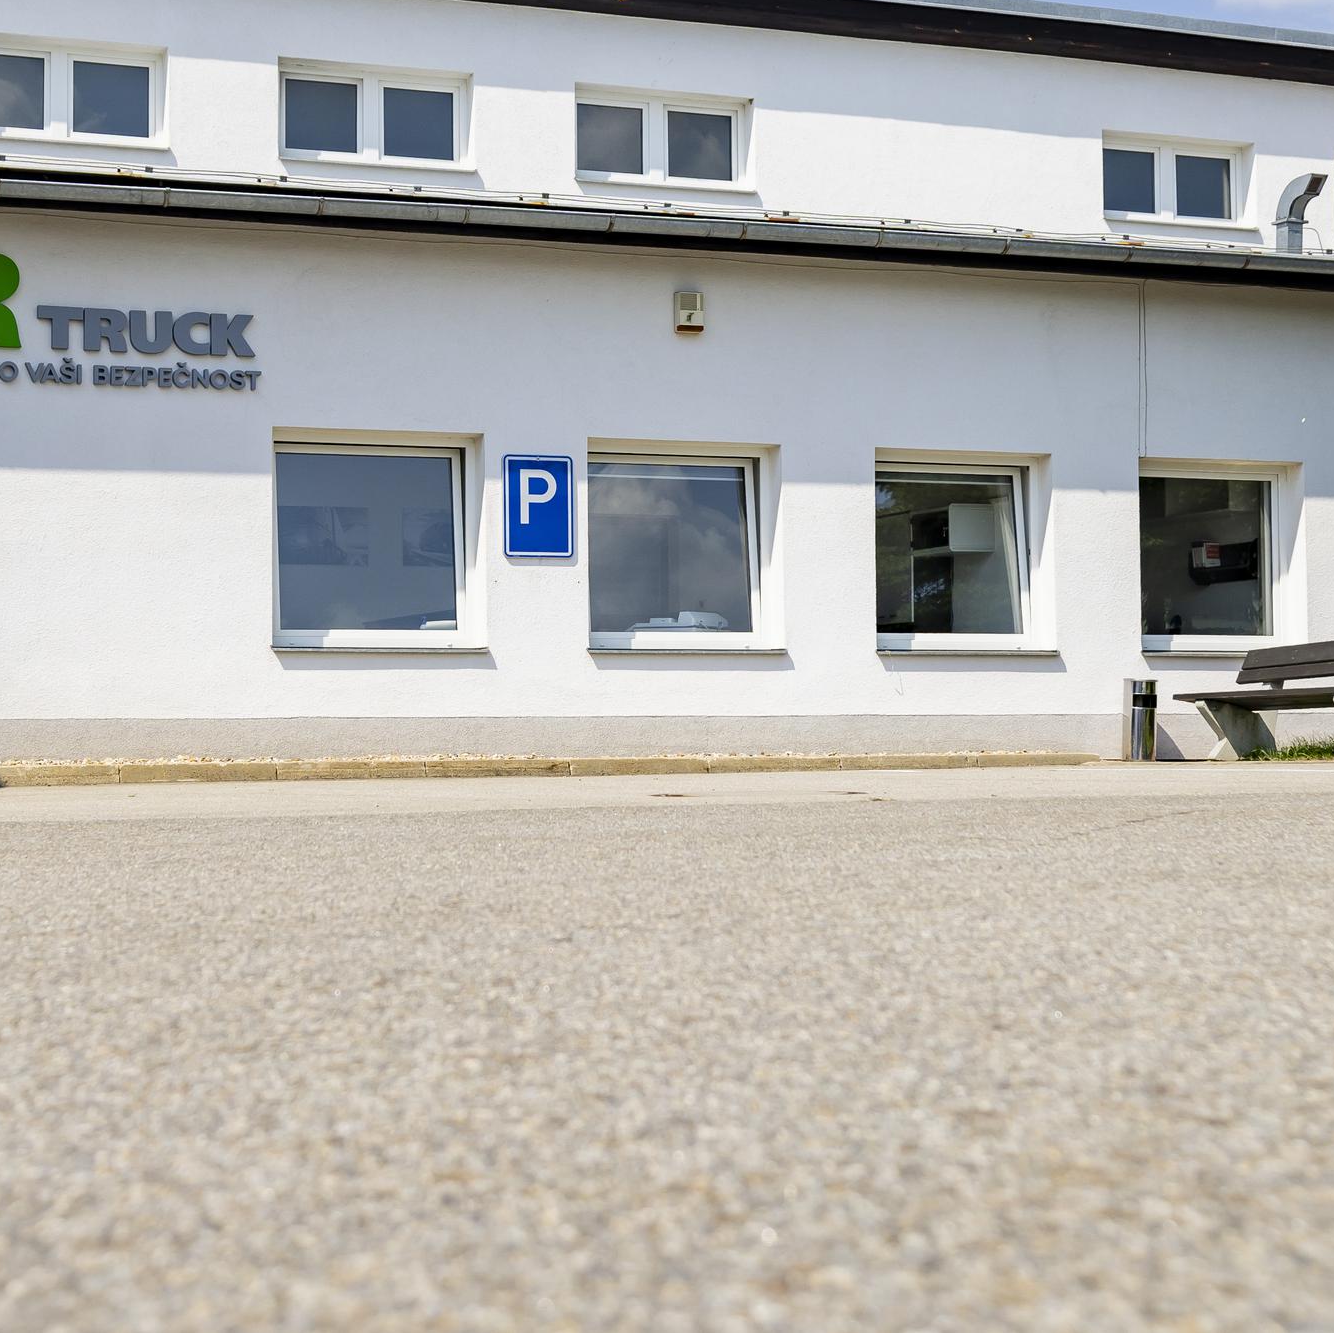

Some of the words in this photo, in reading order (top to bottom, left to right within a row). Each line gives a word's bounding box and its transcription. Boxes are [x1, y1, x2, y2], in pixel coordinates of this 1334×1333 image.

[36, 304, 257, 358] TRUCK
[24, 357, 83, 385] VAŠI
[92, 361, 262, 392] BEZPEČNOST
[519, 468, 558, 525] P
